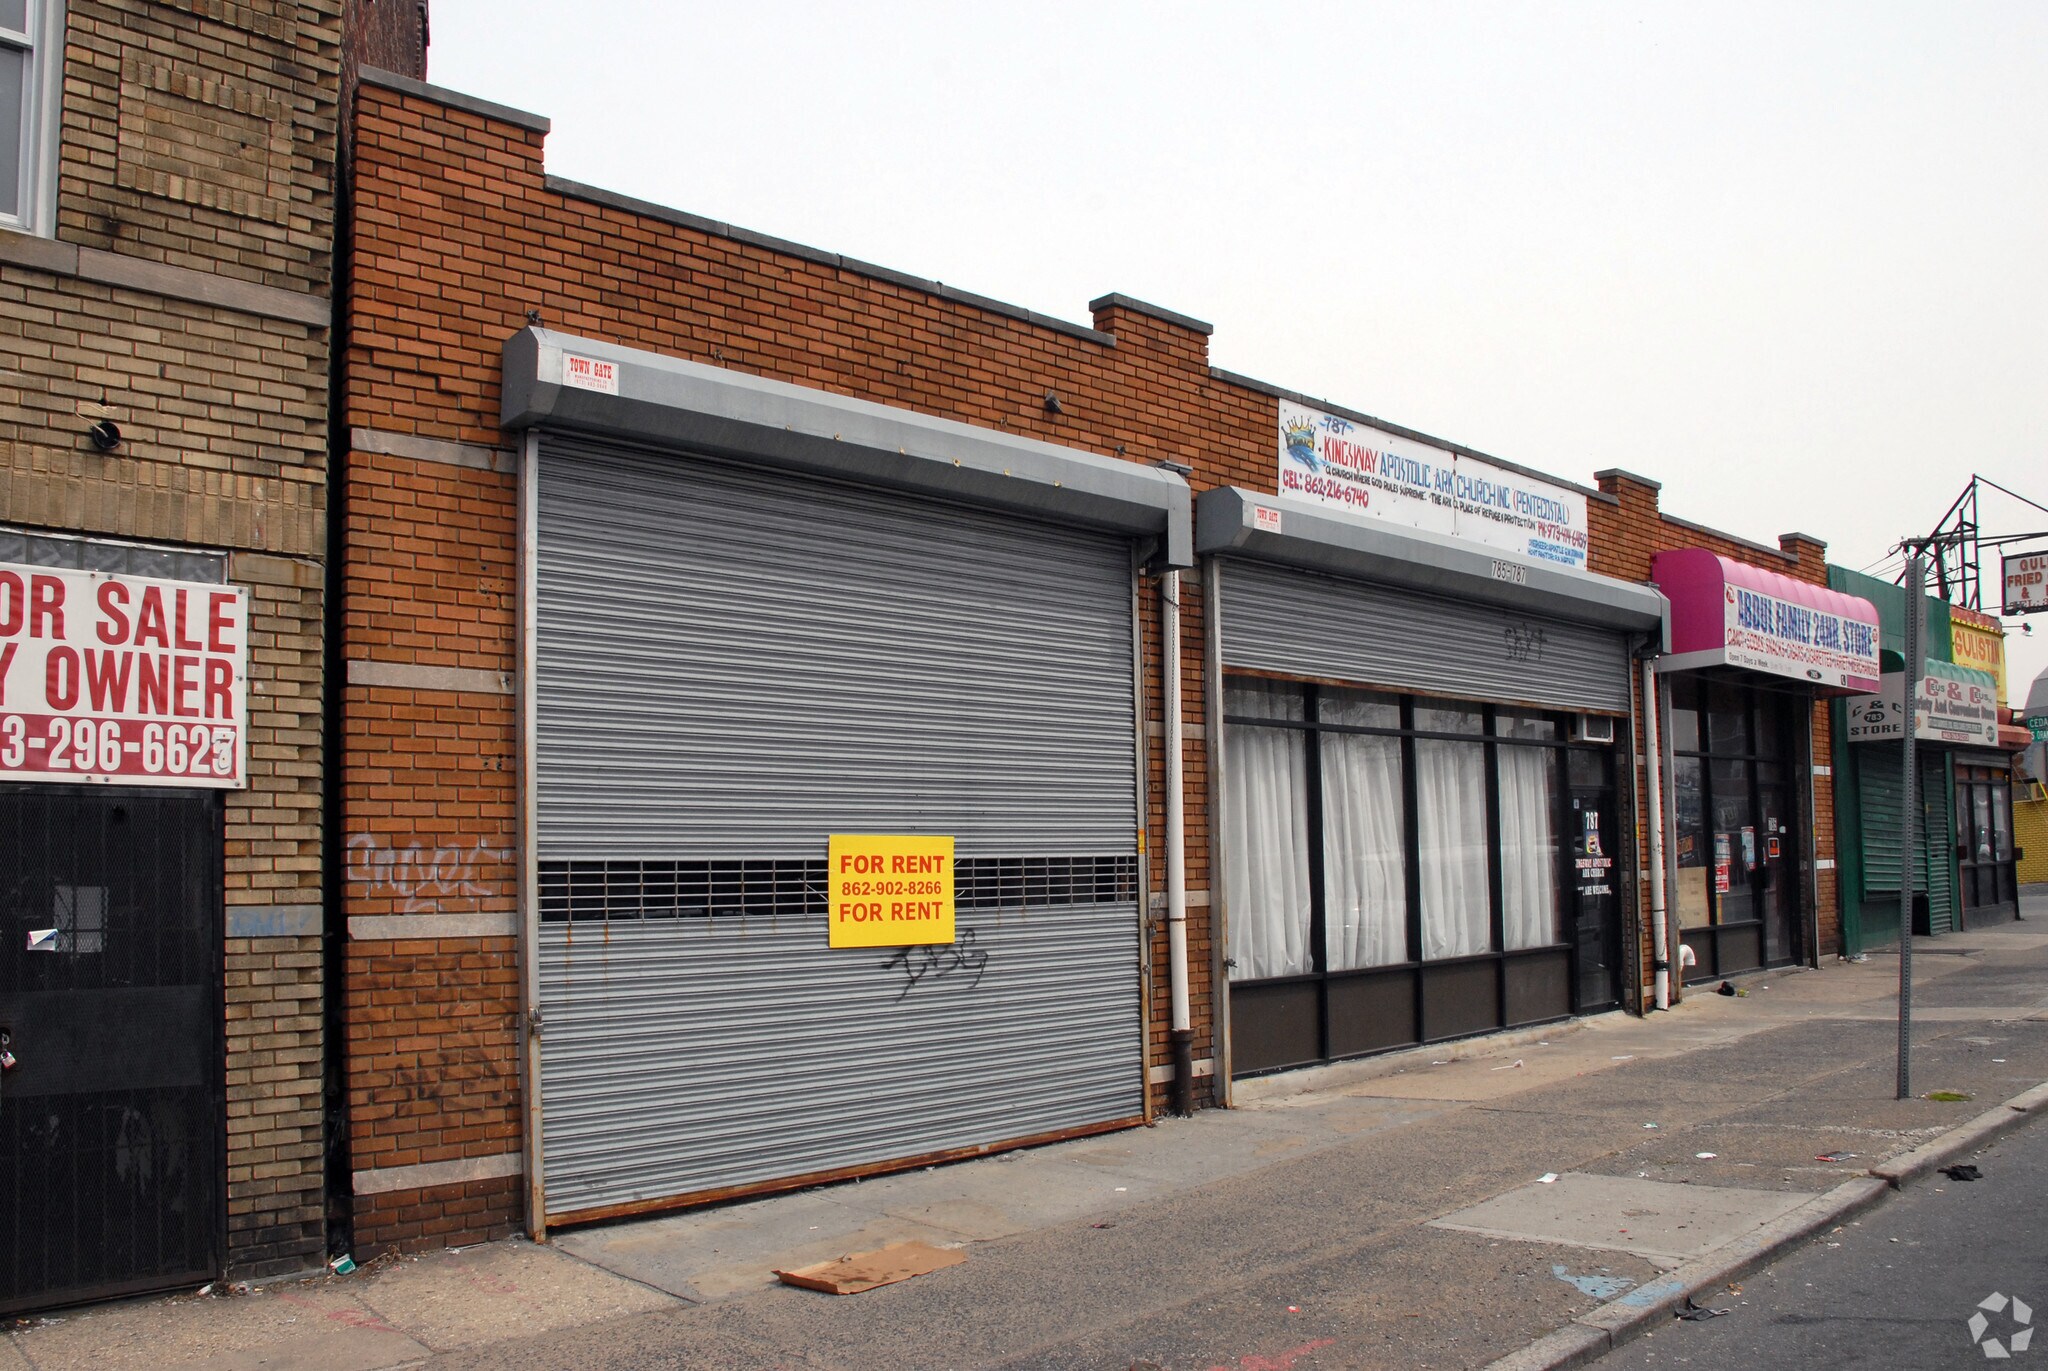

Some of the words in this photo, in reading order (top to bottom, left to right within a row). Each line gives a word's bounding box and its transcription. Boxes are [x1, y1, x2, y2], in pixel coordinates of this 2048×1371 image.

[570, 357, 590, 375] TOWN
[594, 362, 612, 380] GATE
[1282, 468, 1303, 491] CEL:
[1323, 435, 1378, 474] KINGSWAY
[1379, 451, 1431, 489] APOSTOLIC
[1434, 467, 1454, 496] ARK
[1456, 474, 1496, 506] CHURCH
[1497, 485, 1510, 510] INC
[1492, 560, 1526, 583] 785-787
[2007, 571, 2043, 588] FRIED
[2021, 586, 2031, 600] &
[0, 570, 66, 640] OR
[96, 581, 237, 654] SALE
[1737, 589, 1774, 635] ABDUL
[1775, 601, 1811, 644] FAMILY
[1843, 620, 1873, 657] STORE
[45, 645, 234, 720] OWNER
[1947, 682, 1962, 701] &
[1869, 700, 1884, 709] &
[1866, 713, 1882, 721] 783
[1850, 723, 1902, 736] STORE
[1585, 811, 1599, 830] 787
[840, 855, 885, 874] FOR
[892, 855, 945, 874] RENT
[841, 881, 942, 896] 862-902-8266
[839, 903, 883, 922] FOR
[891, 901, 943, 921] RENT
